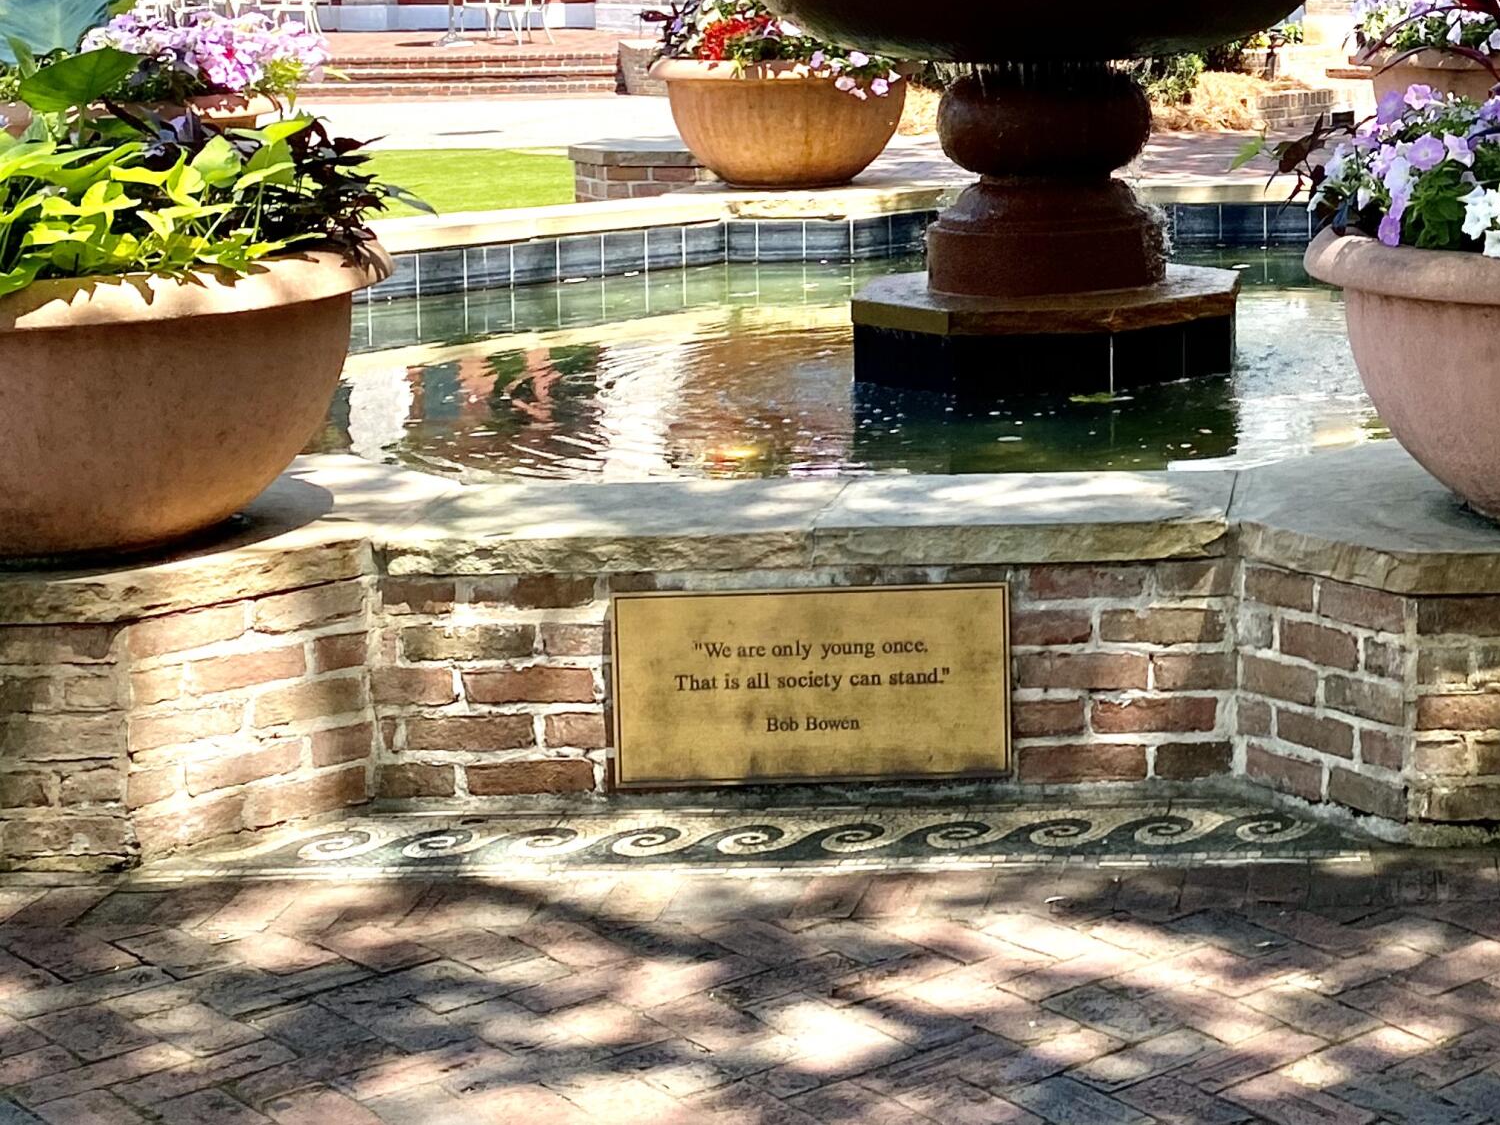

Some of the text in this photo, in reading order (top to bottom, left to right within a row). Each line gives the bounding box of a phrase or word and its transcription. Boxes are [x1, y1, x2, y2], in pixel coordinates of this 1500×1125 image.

[694, 640, 732, 658] "We
[737, 644, 766, 657] are
[771, 640, 812, 660] only
[821, 641, 876, 658] young
[674, 667, 951, 692] That is all society can stand."
[766, 715, 860, 732] Bob Bowen
